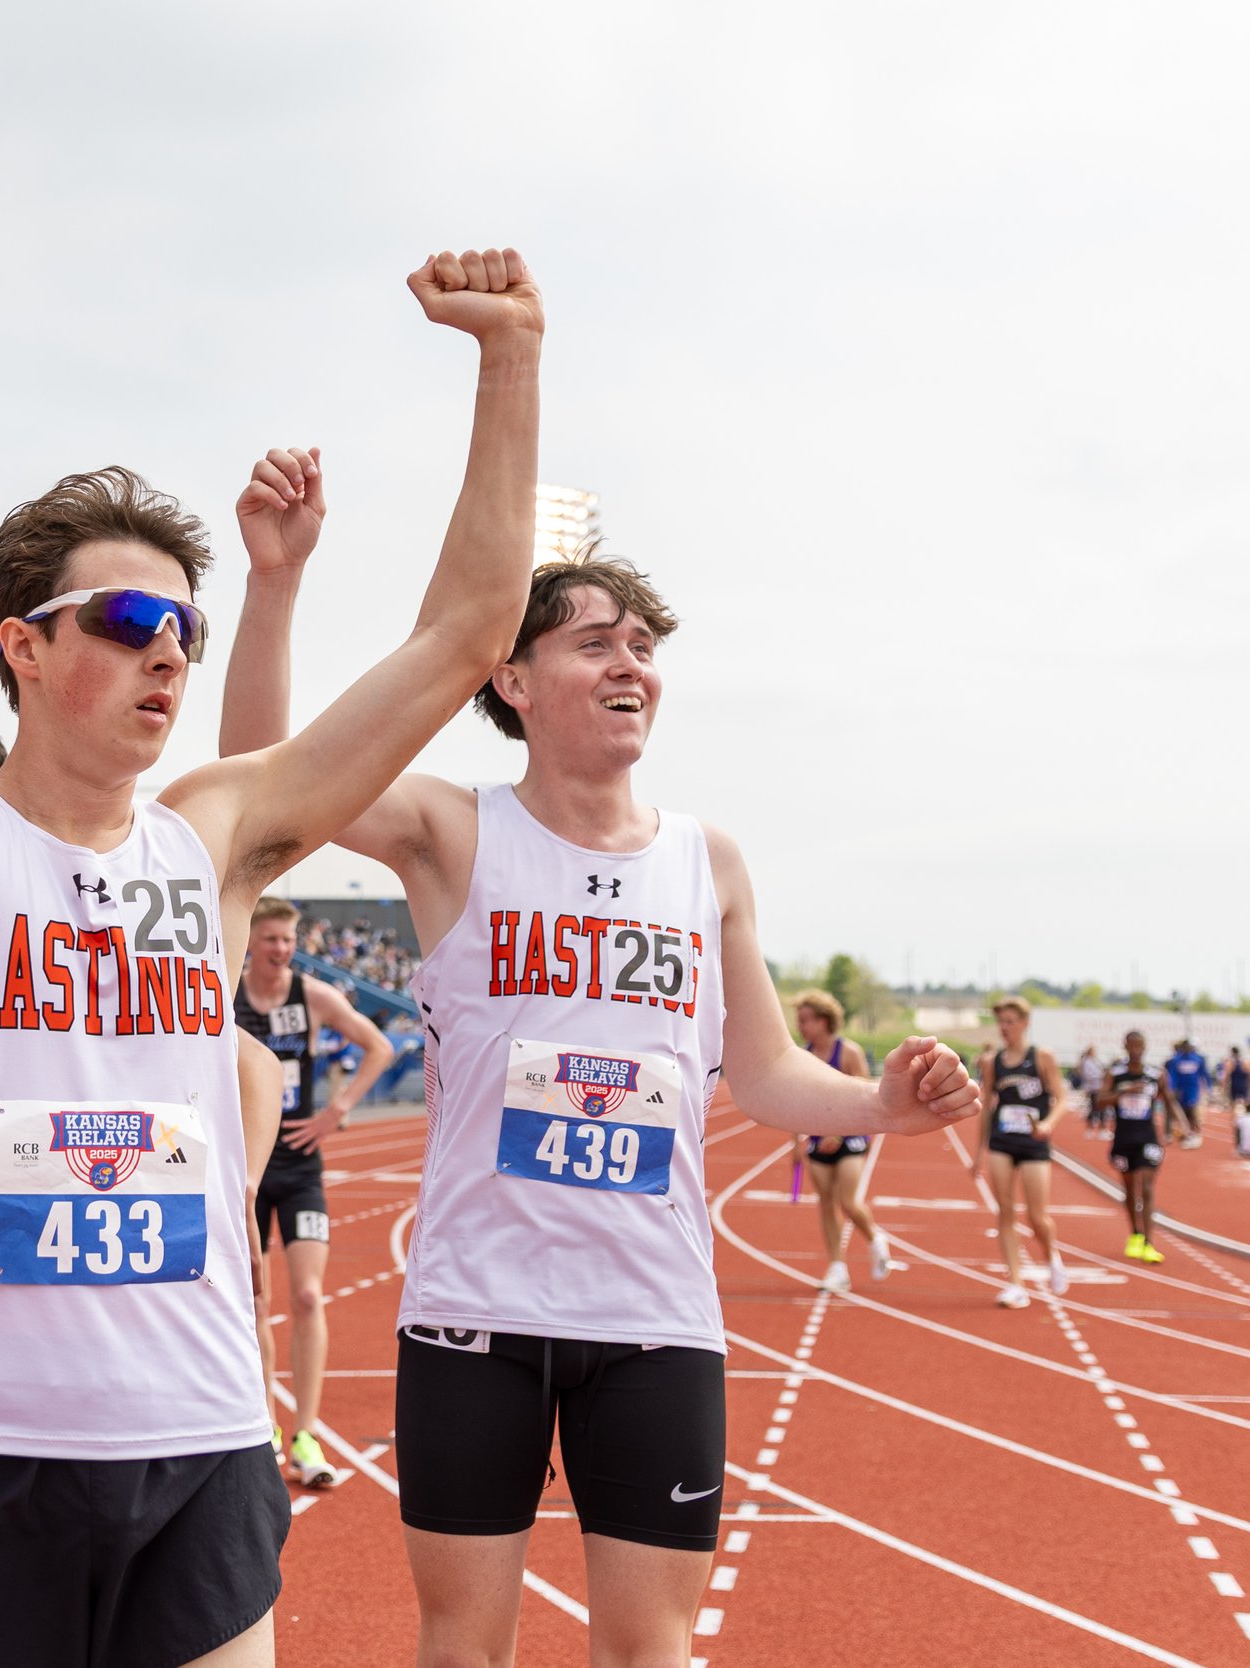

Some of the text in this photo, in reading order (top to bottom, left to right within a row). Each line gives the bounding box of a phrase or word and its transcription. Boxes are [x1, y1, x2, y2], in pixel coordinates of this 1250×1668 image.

[122, 879, 208, 954] 25
[489, 910, 703, 1019] HAST
[615, 929, 684, 997] 25
[569, 1056, 630, 1074] KANSAS
[526, 1072, 546, 1083] RCB
[569, 1068, 627, 1087] RELAYS
[585, 1085, 608, 1095] 2025
[65, 1115, 141, 1130] KANSAS
[67, 1131, 139, 1146] RELAYS
[13, 1143, 39, 1154] RCB
[90, 1149, 118, 1159] 2025
[535, 1119, 640, 1184] 439
[37, 1200, 165, 1275] 433
